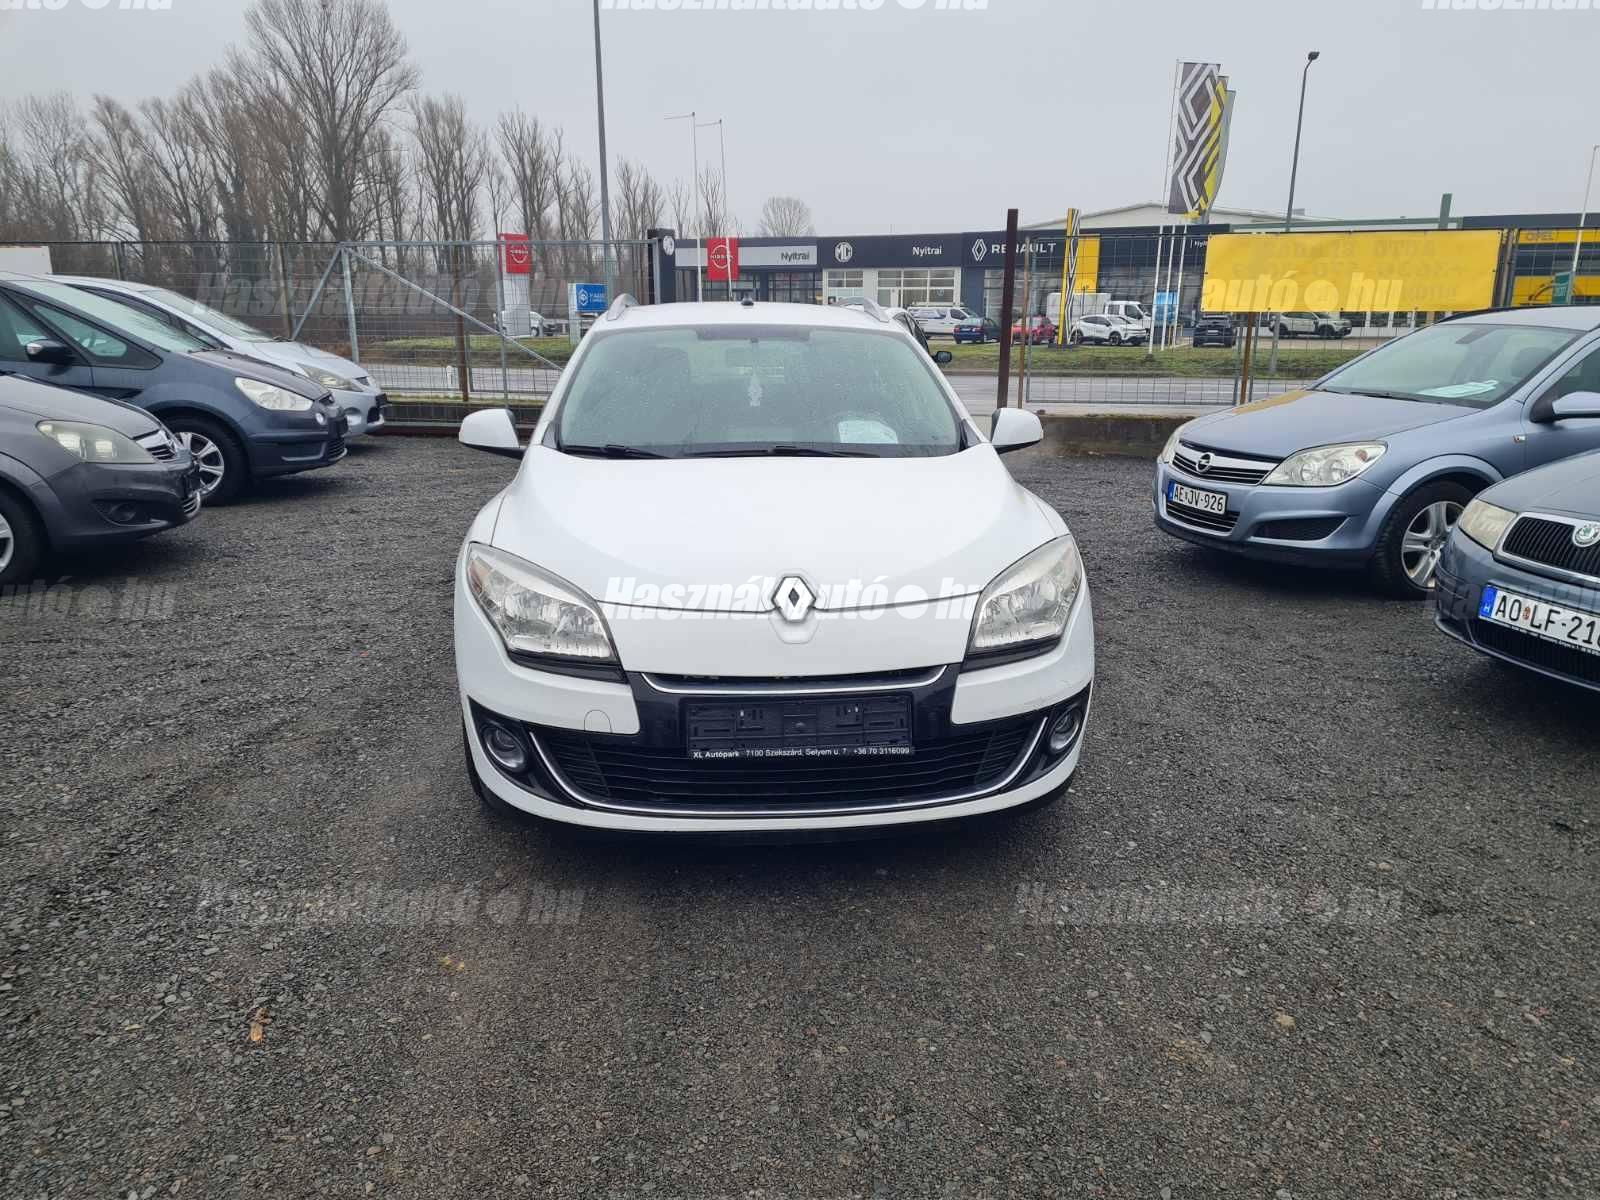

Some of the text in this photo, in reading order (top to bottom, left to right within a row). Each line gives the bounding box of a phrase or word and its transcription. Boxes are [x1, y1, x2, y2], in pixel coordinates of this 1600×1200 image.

[912, 246, 942, 257] Nyitrai
[991, 243, 1056, 253] REAULT
[781, 251, 809, 262] Nyitrai
[1530, 604, 1600, 647] LF-21
[693, 751, 704, 759] XL
